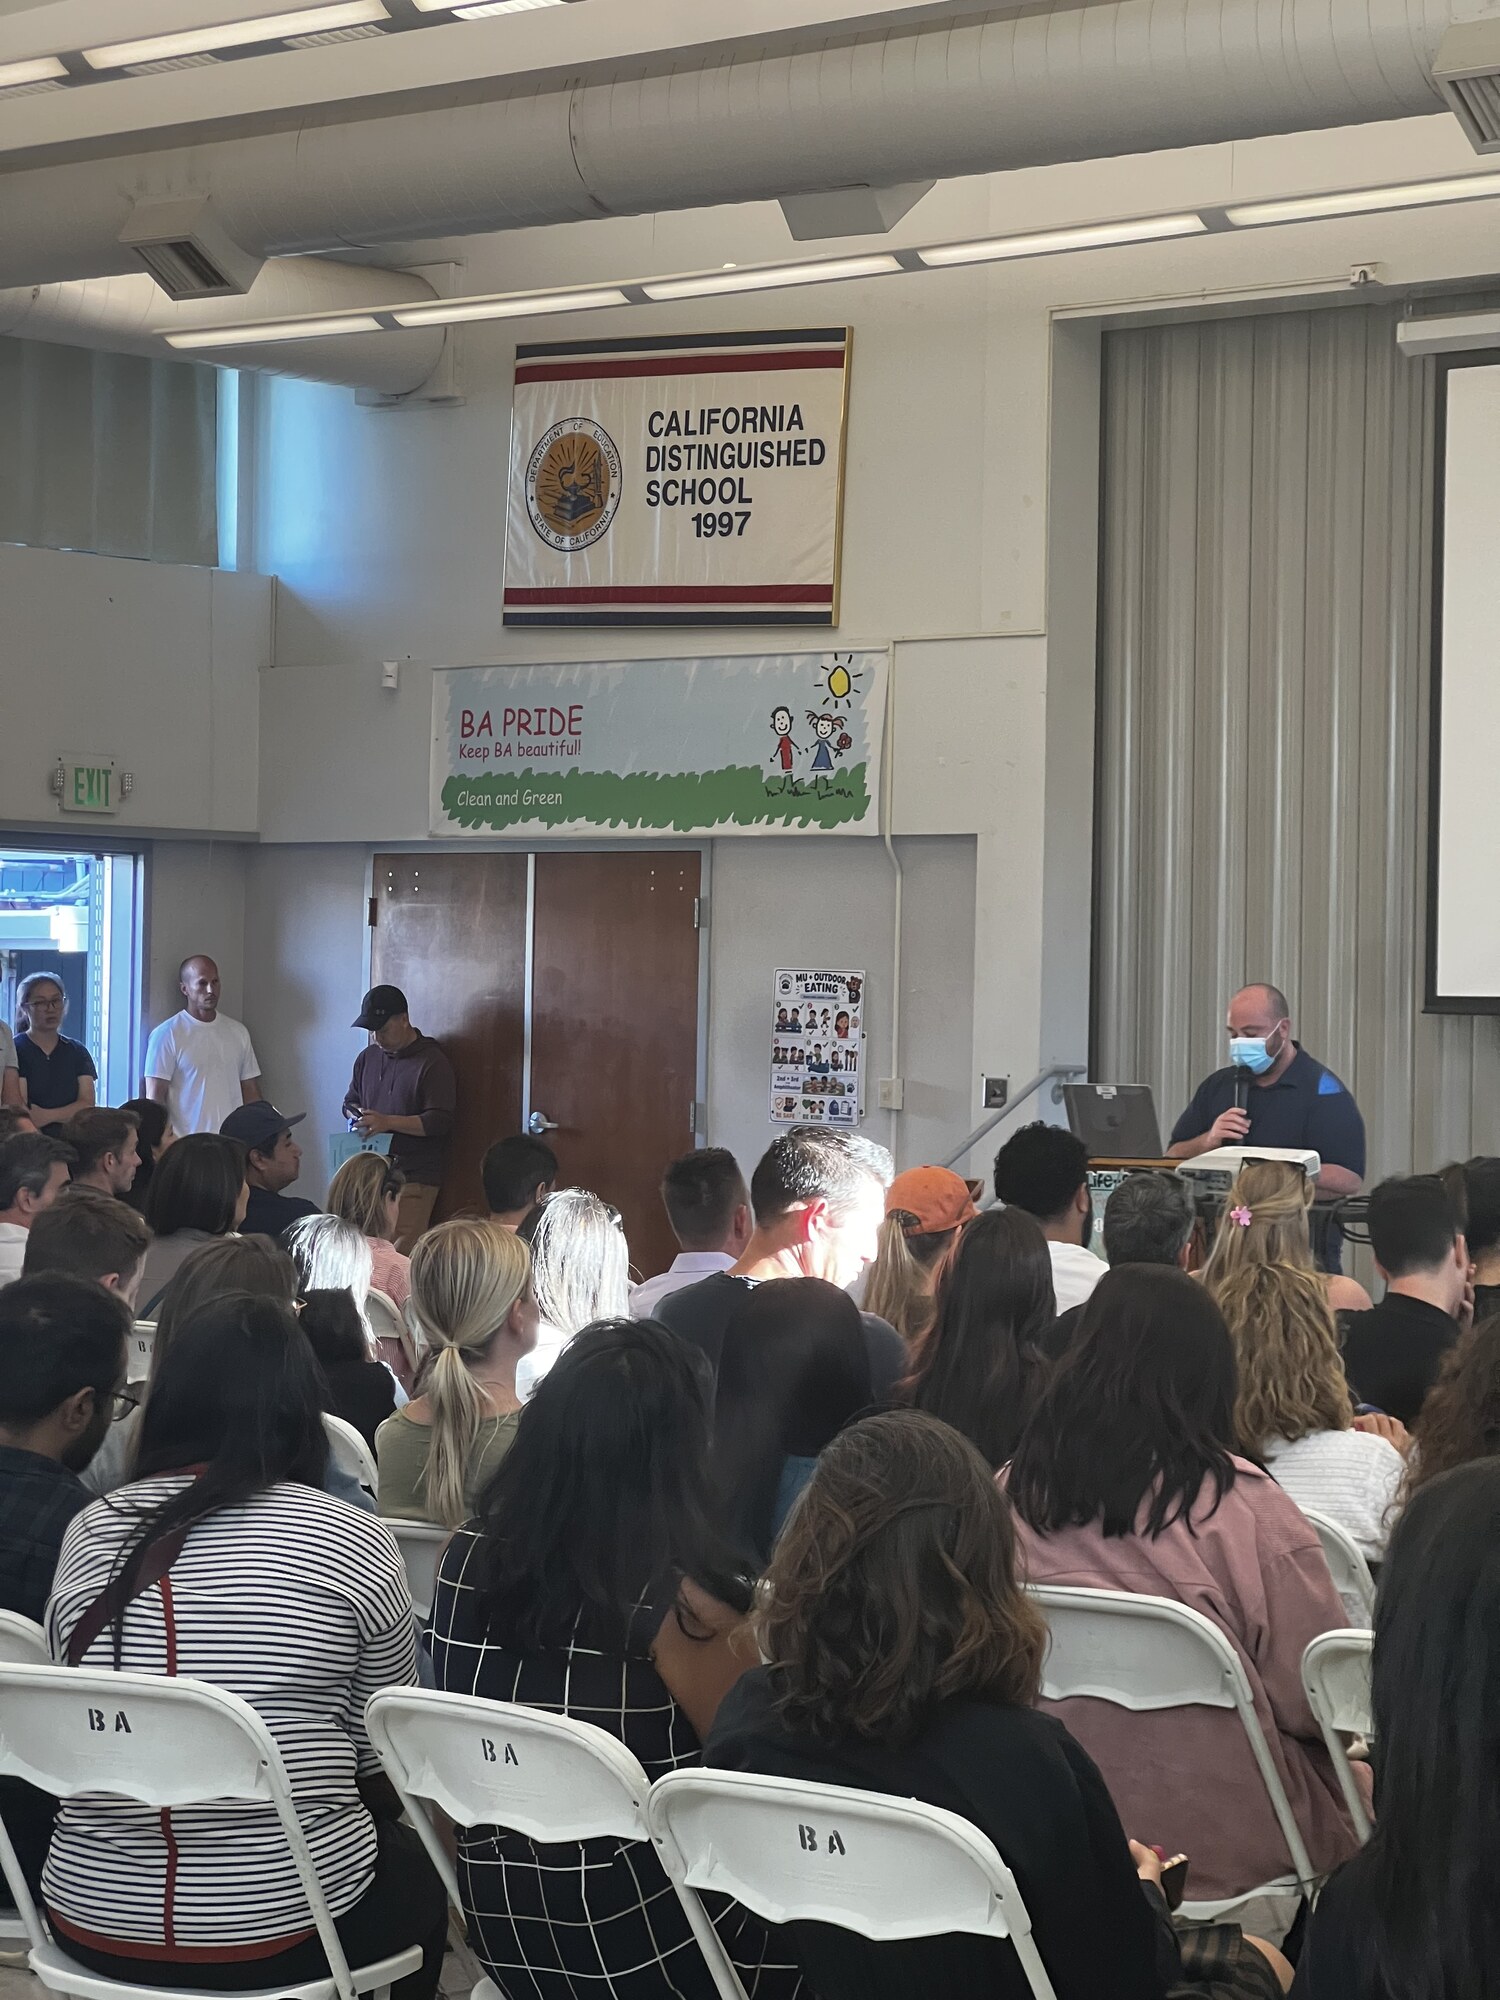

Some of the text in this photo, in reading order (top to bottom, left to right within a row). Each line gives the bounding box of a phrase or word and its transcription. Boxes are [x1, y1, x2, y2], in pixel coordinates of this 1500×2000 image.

[648, 404, 804, 438] CALIFORNIA
[529, 422, 618, 483] DEPARTMENT OF EDUCATION
[646, 438, 826, 473] DISTINGUISHED
[646, 477, 752, 507] SCHOOL
[534, 510, 611, 546] STATE OF CALIFORNIA
[691, 511, 752, 538] 1997
[461, 704, 584, 738] BA PRIDE
[459, 739, 581, 763] Keep BA beautiful!
[74, 767, 112, 807] EXIT
[457, 789, 563, 806] Clean and Green
[796, 973, 808, 983] MU
[814, 972, 847, 985] OUTDOOR
[804, 982, 839, 994] EATING
[87, 1708, 132, 1733] BA
[481, 1738, 519, 1766] BA
[798, 1824, 846, 1856] BA
